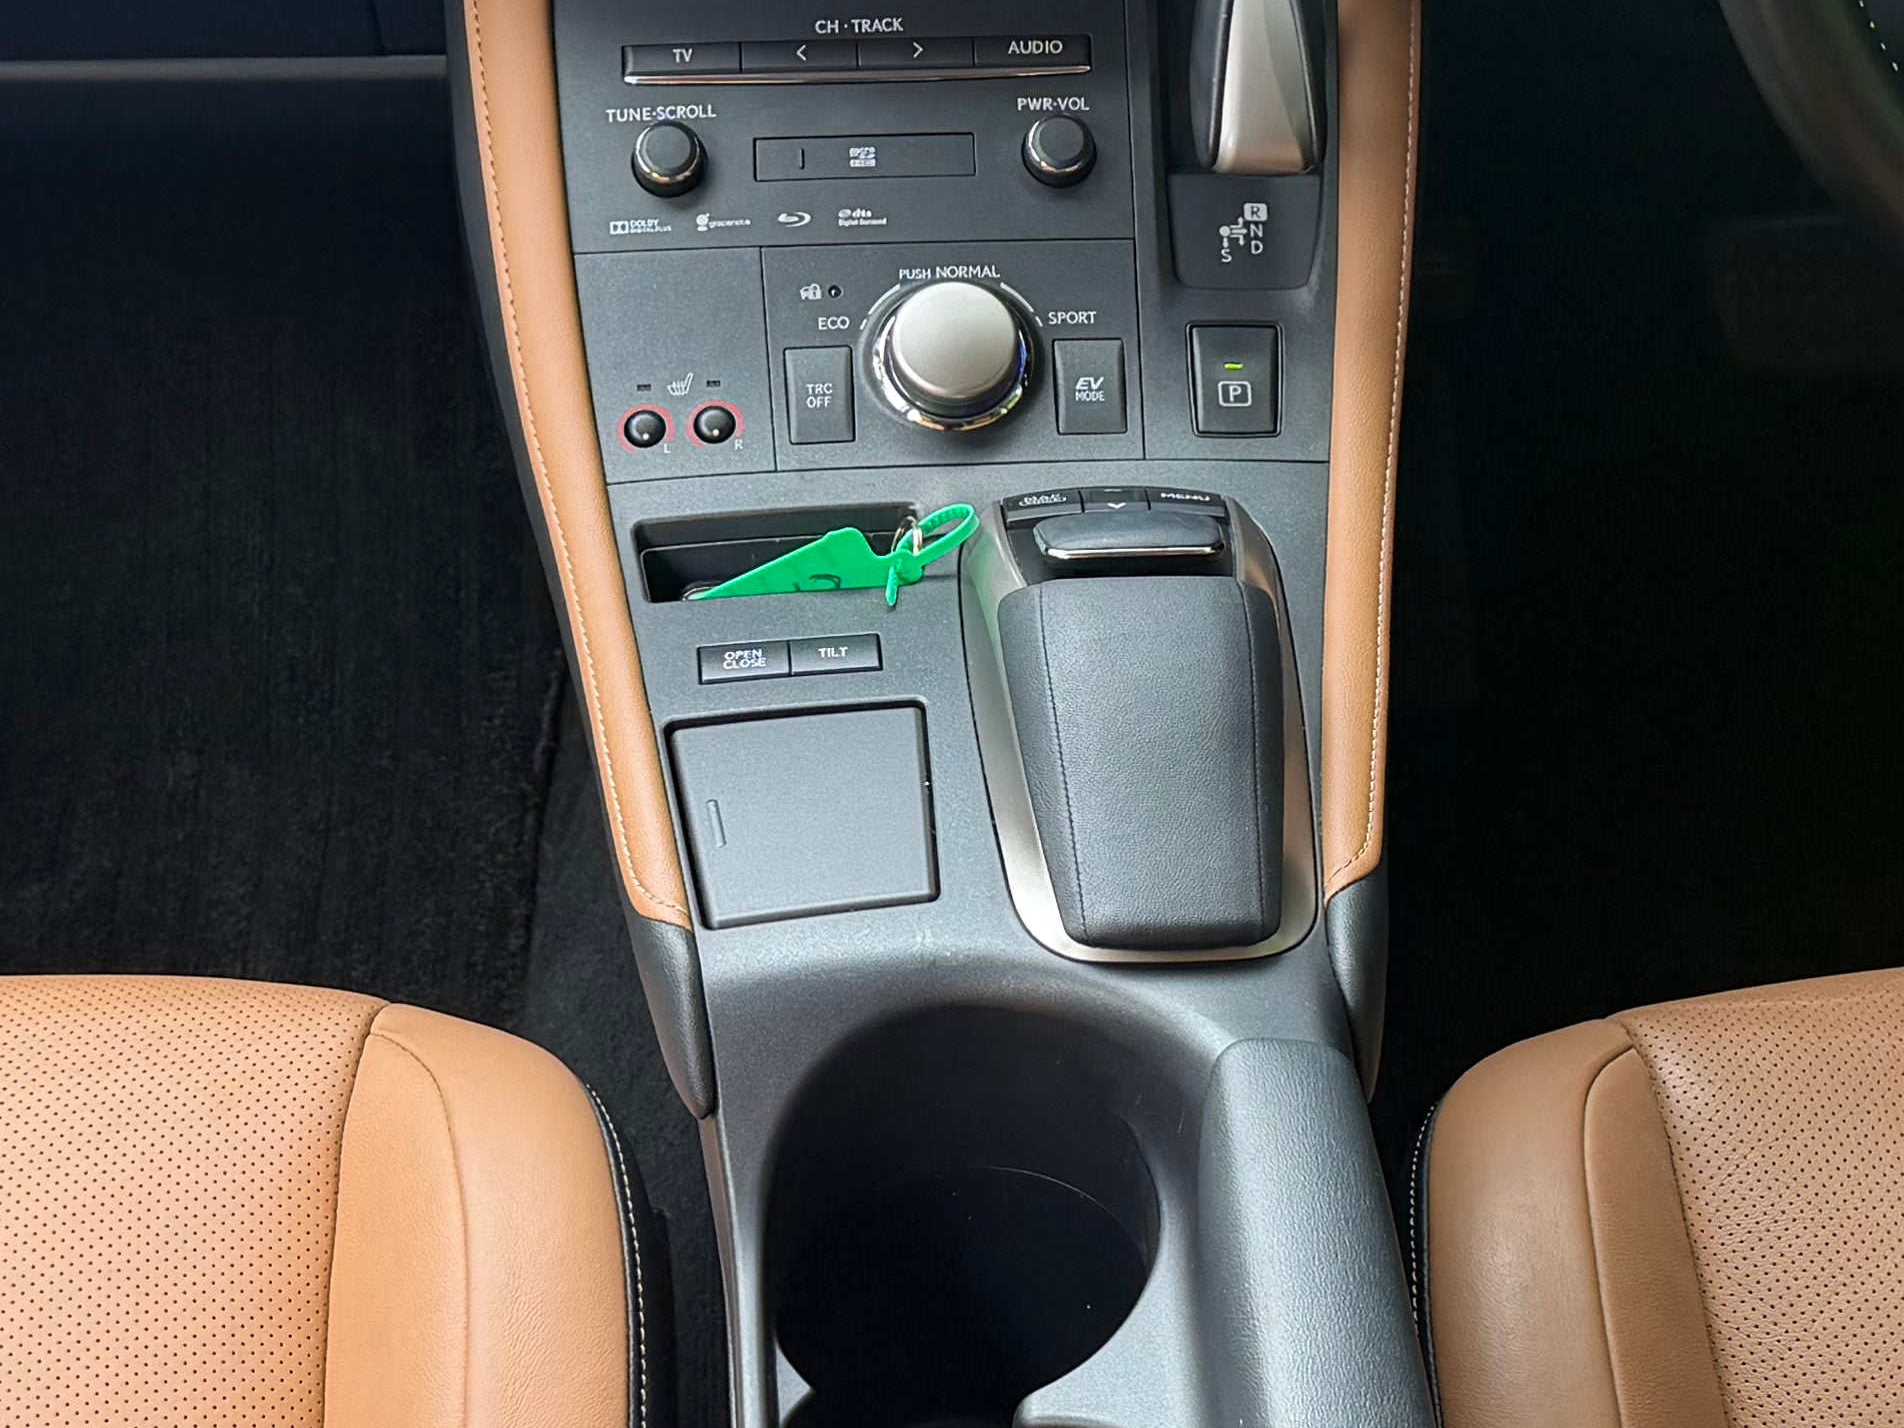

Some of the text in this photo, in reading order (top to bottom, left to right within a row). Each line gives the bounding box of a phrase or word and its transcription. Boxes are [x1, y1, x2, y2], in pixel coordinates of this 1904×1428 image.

[815, 20, 839, 34] CH
[851, 17, 904, 33] TRACK
[1007, 39, 1063, 55] AUDIO
[672, 48, 693, 63] TV
[1250, 205, 1262, 218] R
[1249, 224, 1264, 238] N
[1251, 239, 1264, 255] D
[1221, 249, 1232, 263] S
[899, 265, 1000, 280] PUSH NORMAL
[818, 316, 850, 331] ECO
[1048, 311, 1097, 325] SPORT
[807, 383, 833, 395] TRC
[1075, 377, 1104, 390] EV
[1075, 390, 1105, 402] MODE
[1229, 385, 1242, 402] P
[807, 395, 832, 408] OFF
[663, 443, 672, 454] L
[734, 439, 743, 450] R
[724, 648, 763, 660] OPEN
[818, 646, 849, 658] TILT
[723, 657, 767, 670] CLOSE
